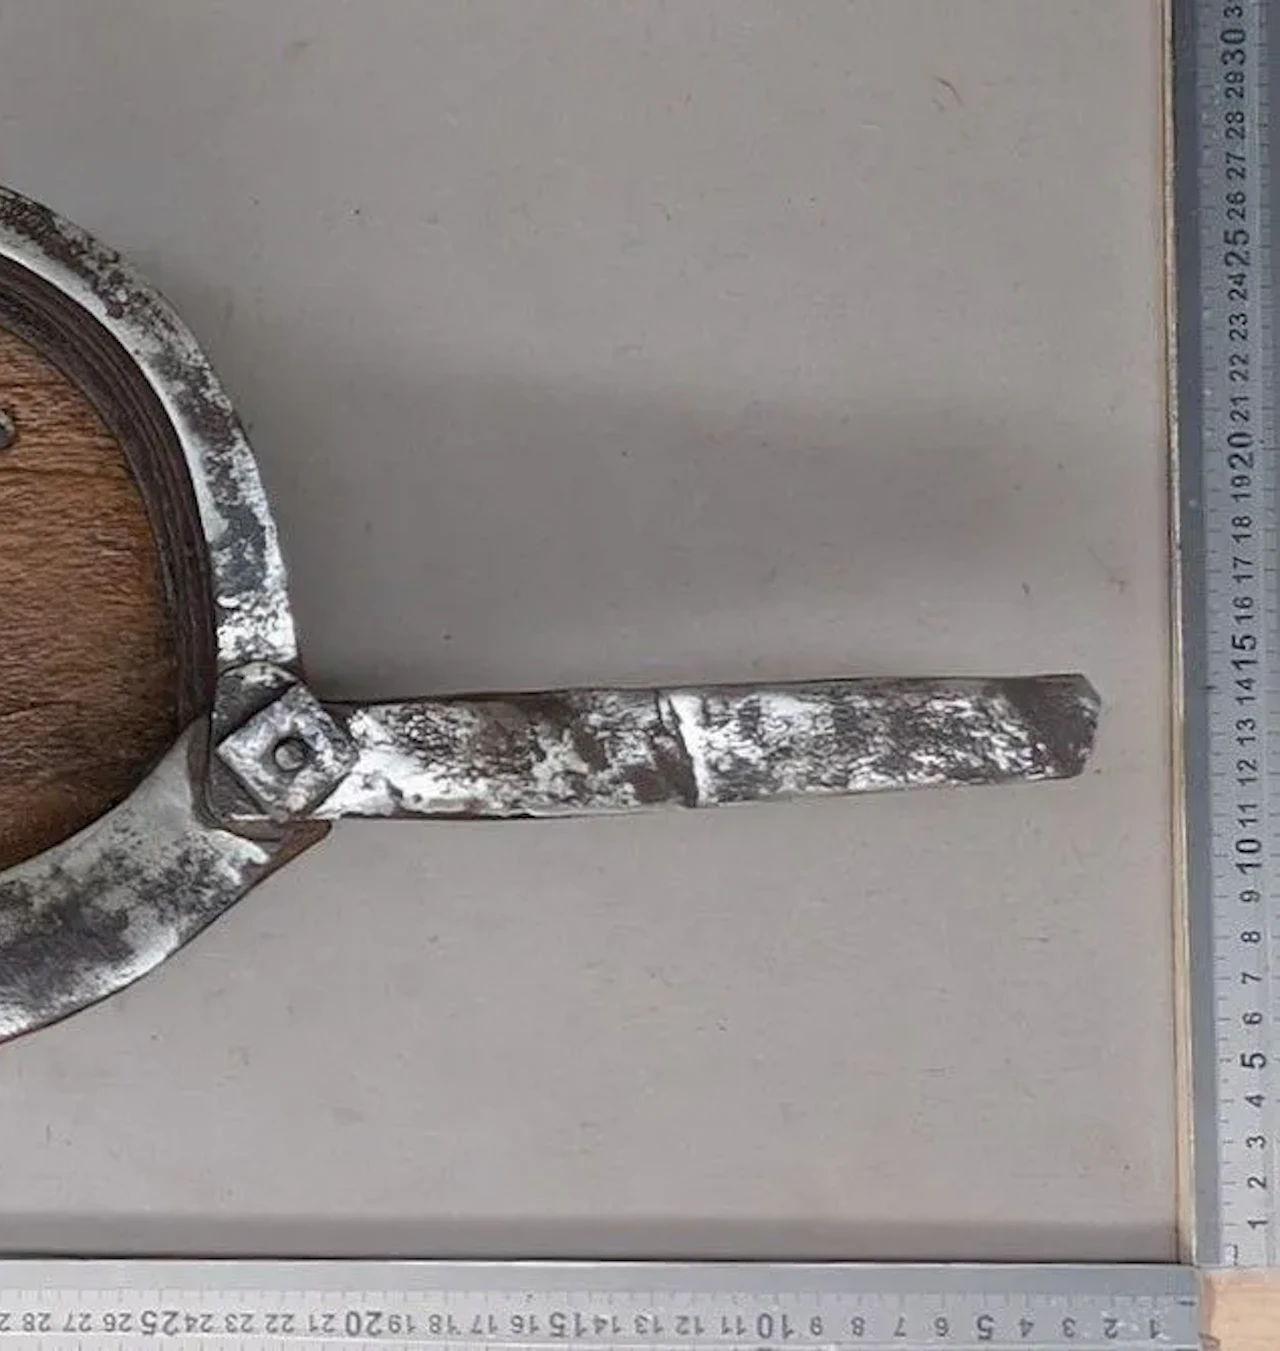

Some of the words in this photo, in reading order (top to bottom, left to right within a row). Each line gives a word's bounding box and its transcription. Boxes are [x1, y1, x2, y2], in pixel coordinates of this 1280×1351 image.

[1223, 0, 1243, 18] 3
[1220, 29, 1245, 65] 30
[1225, 111, 1245, 140] 28
[1226, 152, 1245, 180] 27
[1226, 191, 1245, 220] 26
[1224, 229, 1250, 266] 25
[1228, 273, 1247, 300] 24
[1229, 313, 1247, 341] 23
[1229, 354, 1248, 382] 22
[1230, 397, 1249, 422] 21
[1227, 432, 1252, 469] 20
[1231, 475, 1251, 502] 19
[1232, 516, 1252, 543] 18
[1232, 557, 1253, 583] 17
[1233, 597, 1253, 624] 16
[1232, 635, 1257, 670] 15
[1235, 678, 1255, 705] 14
[1236, 719, 1255, 746] 13
[1236, 760, 1257, 786] 12
[1238, 804, 1258, 827] 11
[1236, 839, 1261, 874] 10
[1239, 890, 1261, 902] 9
[1241, 931, 1261, 943] 8
[1241, 972, 1262, 984] 7
[1242, 1013, 1262, 1025] 6
[1241, 1053, 1266, 1069] 5
[1245, 1095, 1265, 1107] 4
[1246, 1136, 1266, 1148] 3
[1247, 1177, 1267, 1189] 2
[1248, 1220, 1268, 1229] 1
[22, 1313, 52, 1333] 28
[62, 1313, 92, 1333] 27
[141, 1311, 180, 1336] 25
[184, 1314, 213, 1334] 24
[225, 1314, 254, 1334] 23
[266, 1314, 295, 1334] 22
[309, 1314, 336, 1334] 21
[346, 1311, 383, 1336] 20
[388, 1315, 416, 1335] 19
[470, 1315, 498, 1335] 17
[550, 1312, 587, 1337] 15
[594, 1315, 621, 1335] 14
[634, 1315, 664, 1335] 13
[676, 1316, 704, 1336] 12
[722, 1316, 746, 1336] 11
[757, 1313, 794, 1338] 10
[810, 1316, 823, 1336] 9
[851, 1317, 865, 1337] 8
[894, 1317, 906, 1337] 7
[935, 1317, 949, 1337] 6
[977, 1315, 994, 1340] 5
[1019, 1318, 1034, 1338] 4
[1062, 1317, 1076, 1337] 3
[1104, 1318, 1117, 1338] 2
[1149, 1319, 1160, 1339] 1
